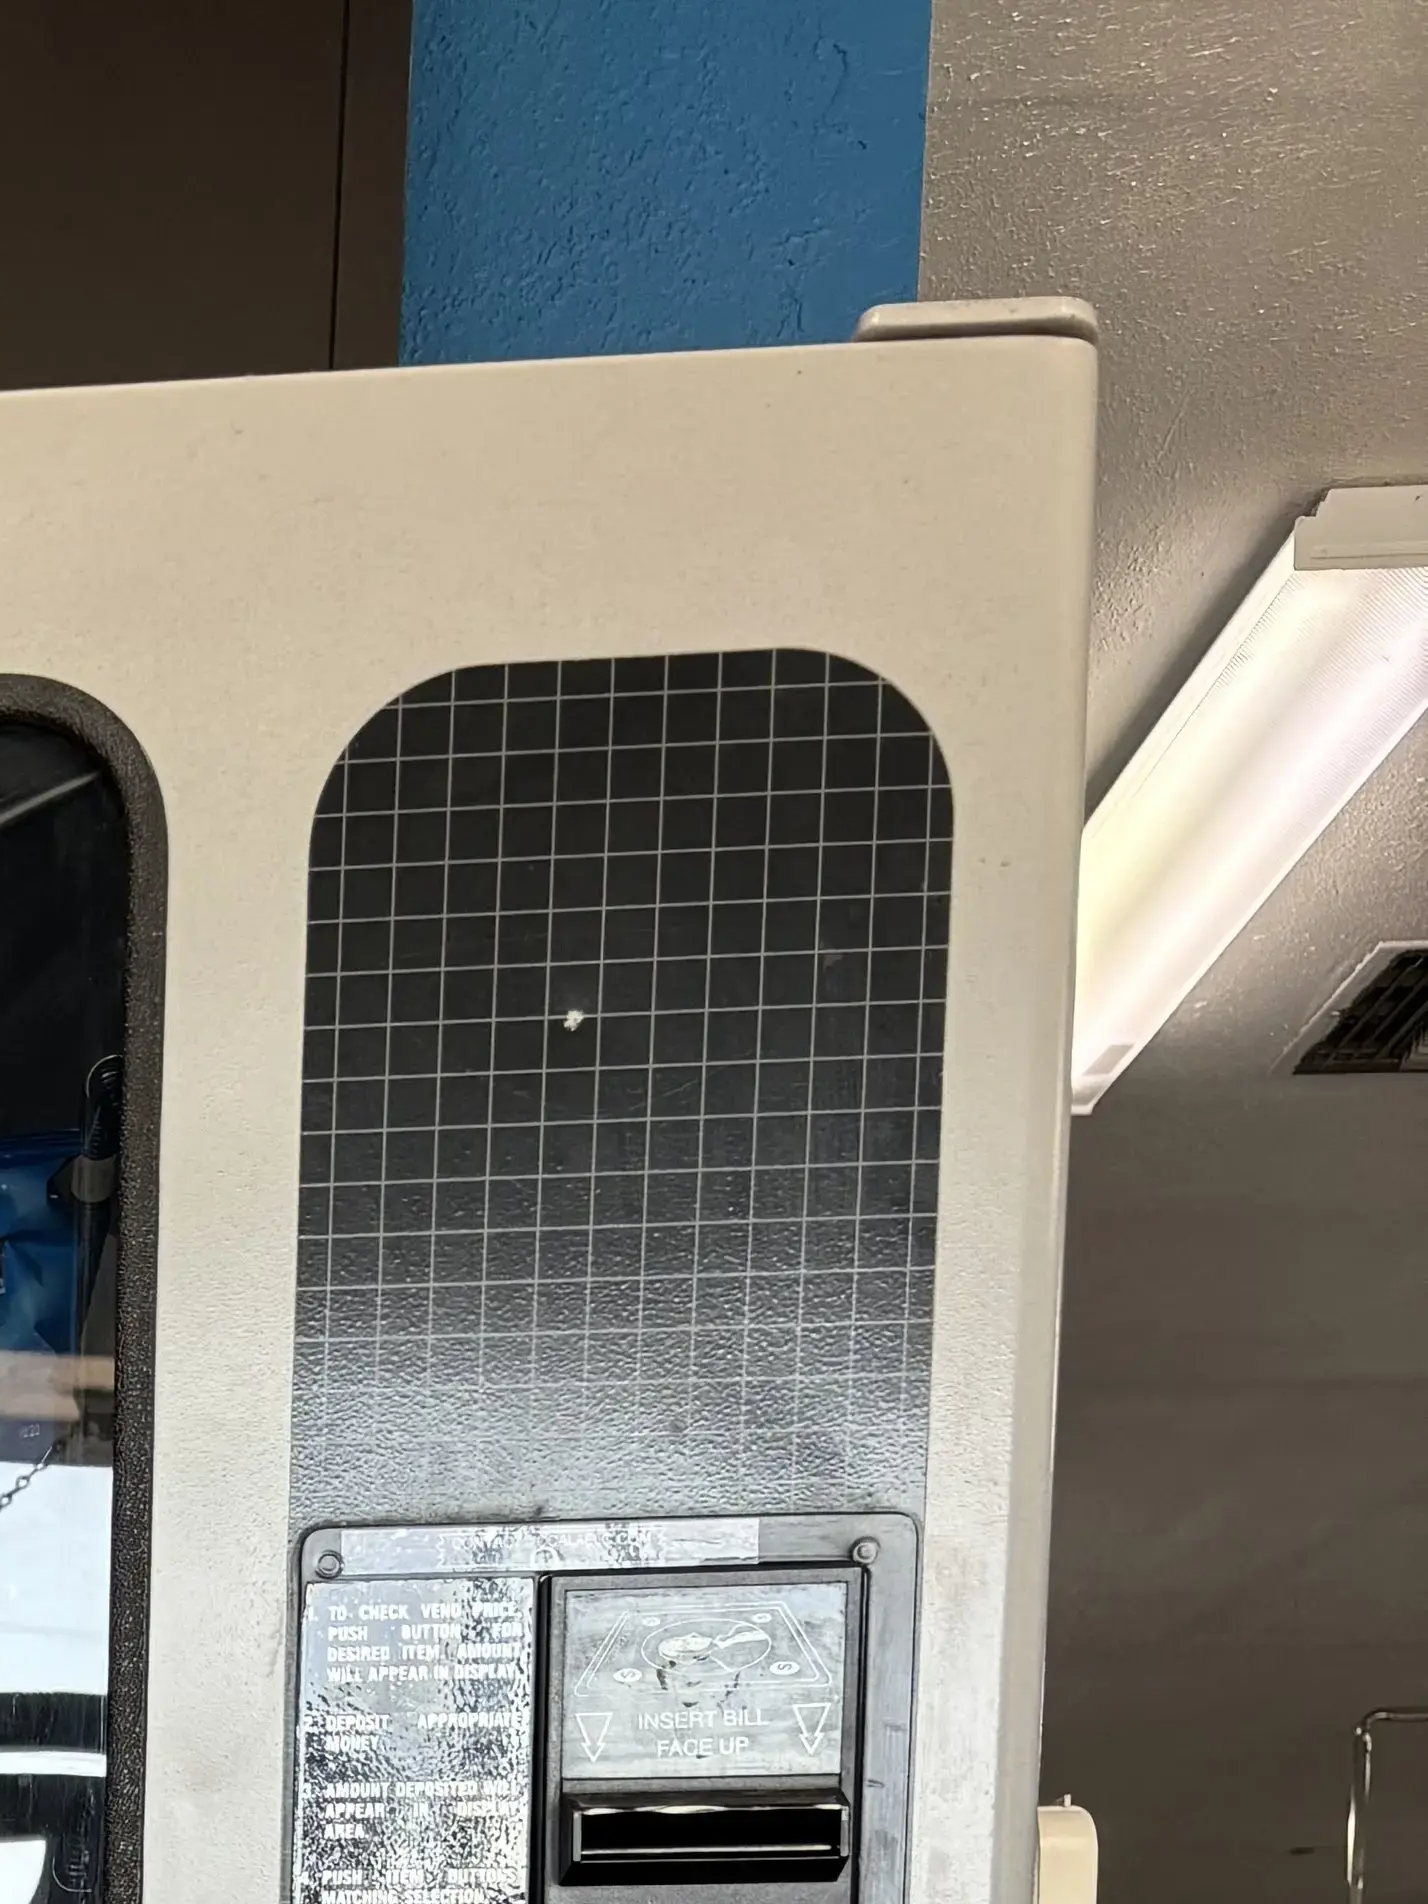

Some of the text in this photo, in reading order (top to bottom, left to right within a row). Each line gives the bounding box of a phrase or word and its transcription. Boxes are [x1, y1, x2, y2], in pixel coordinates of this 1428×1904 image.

[358, 1604, 409, 1620] CHECK
[328, 1624, 461, 1642] PUSH BUTTON
[327, 1646, 390, 1662] DESIRED
[327, 1665, 429, 1682] WILL APPEAR
[638, 1706, 769, 1730] INSERT BILL
[656, 1736, 749, 1757] FACE UP
